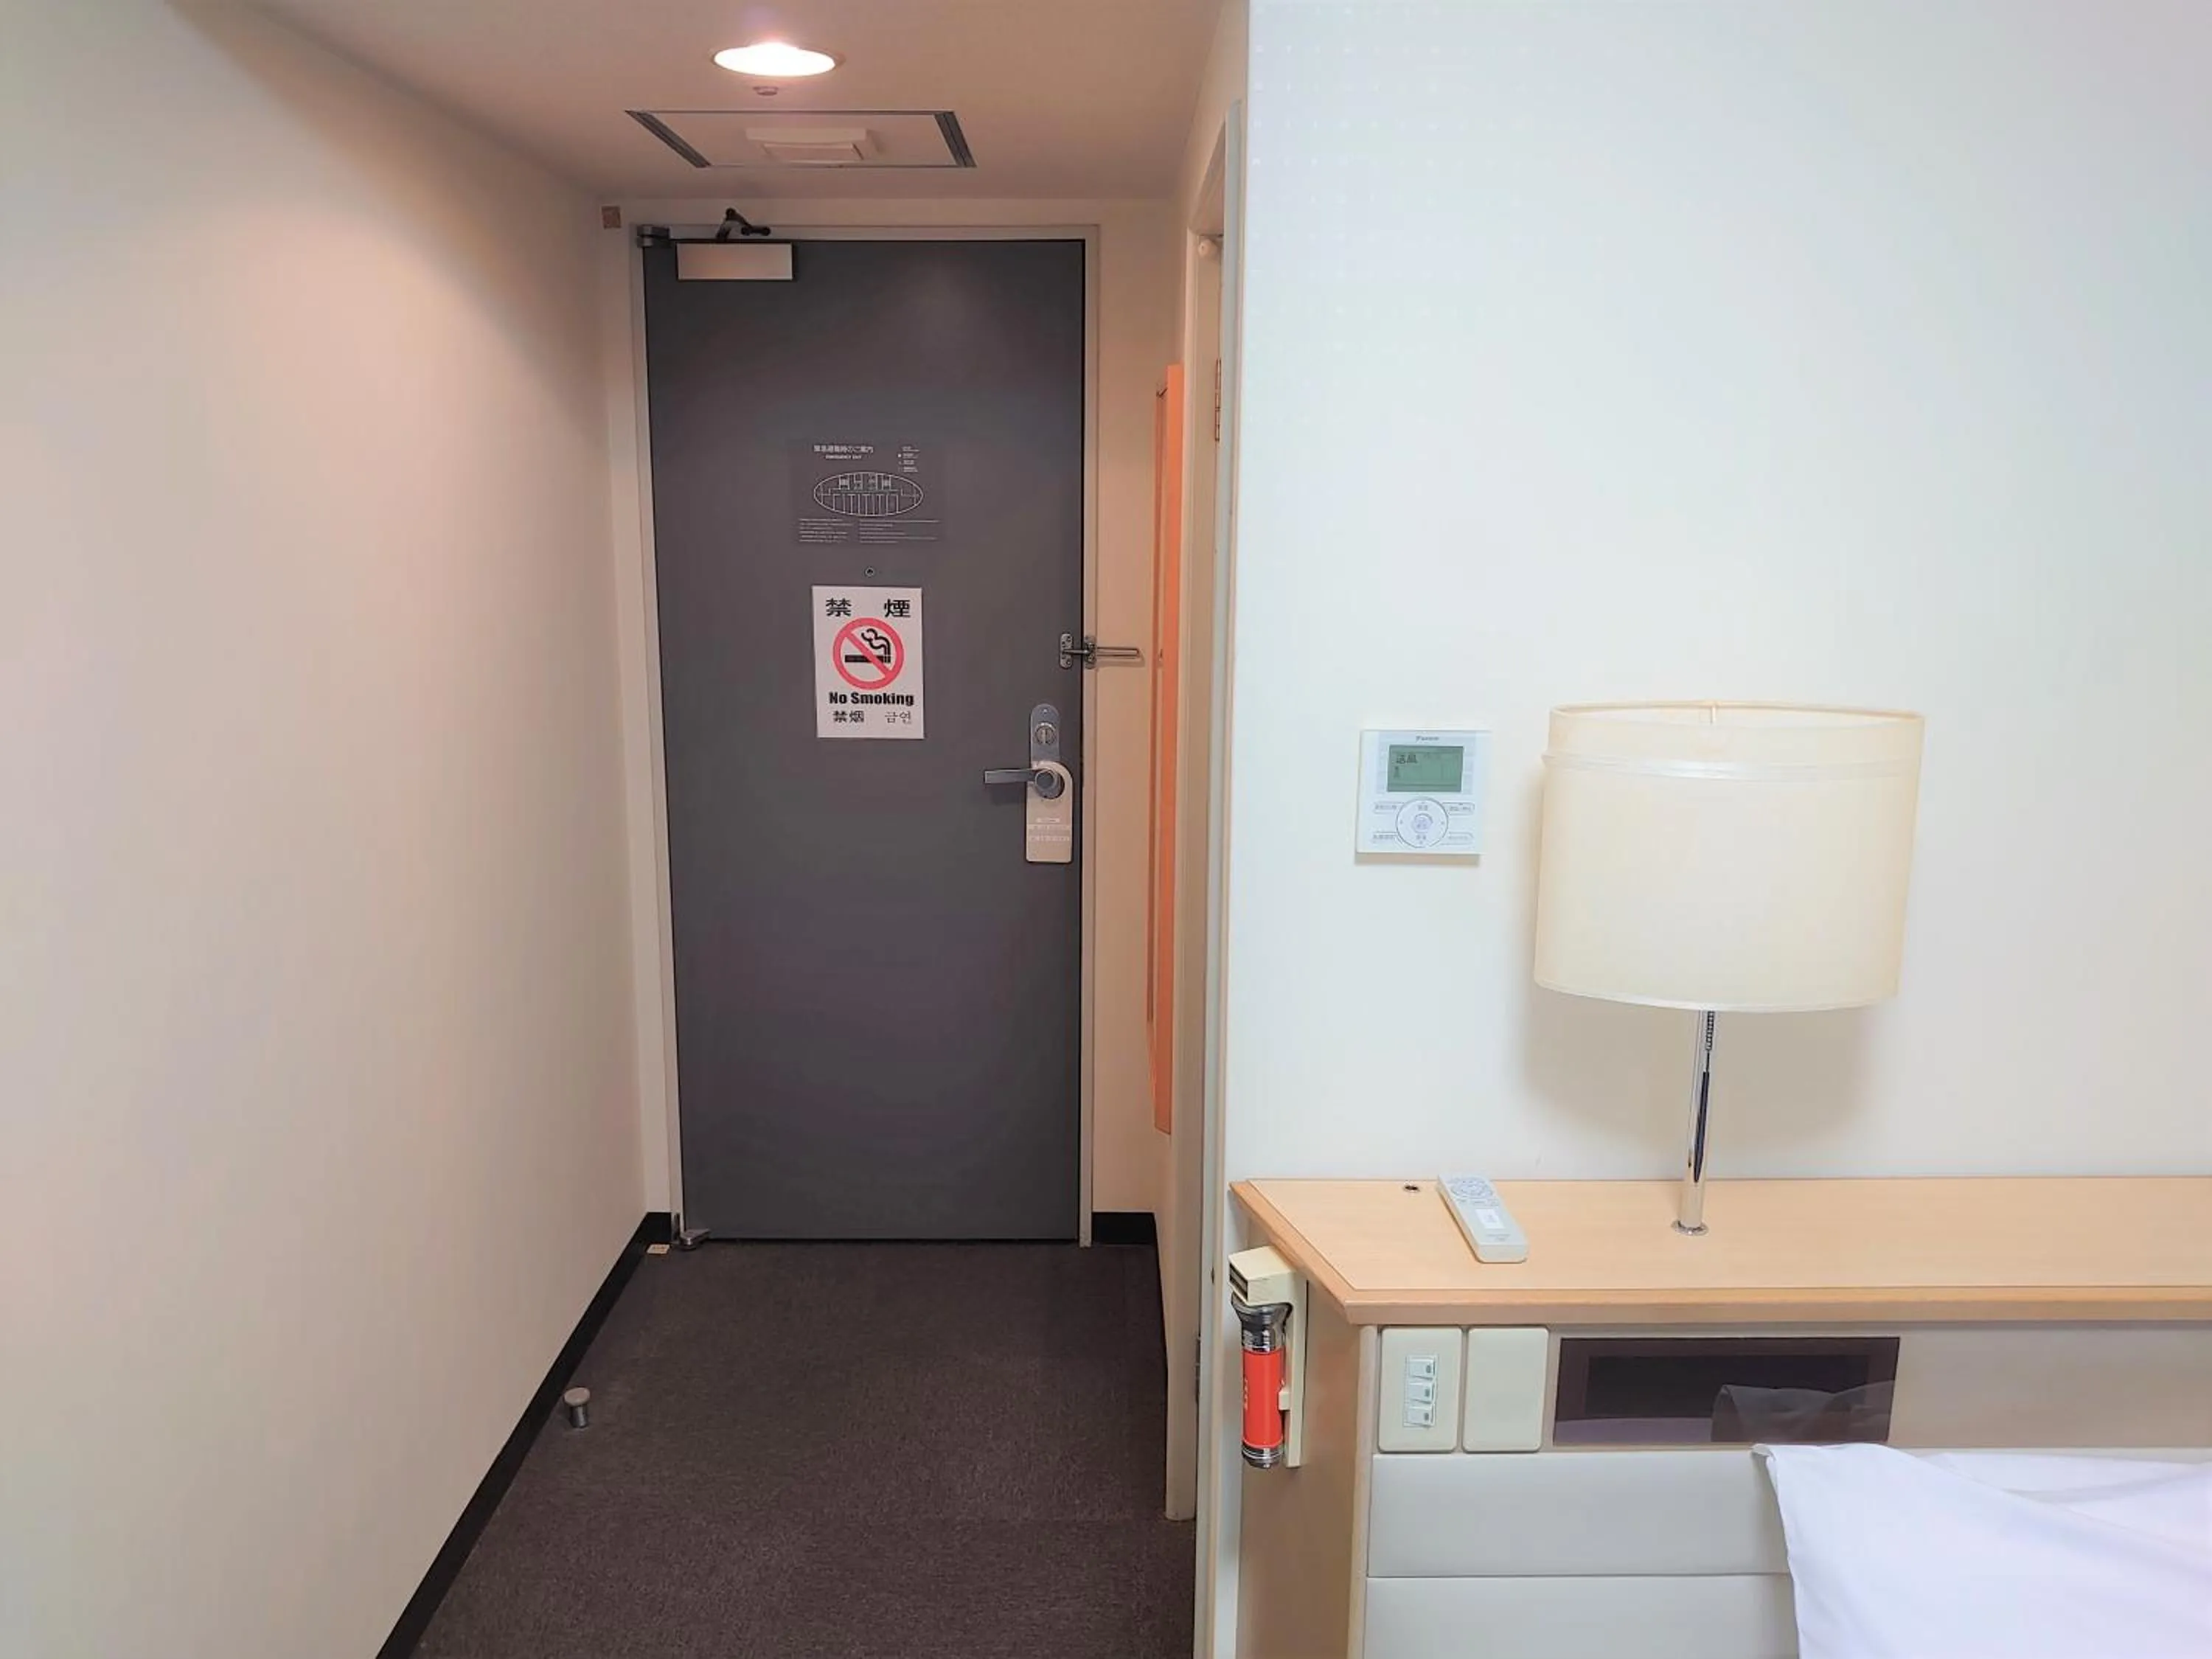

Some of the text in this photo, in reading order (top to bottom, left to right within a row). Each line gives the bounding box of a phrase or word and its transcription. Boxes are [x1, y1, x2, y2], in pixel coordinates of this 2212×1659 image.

[825, 597, 911, 618] 禁 煙
[828, 691, 914, 706] No Smoking
